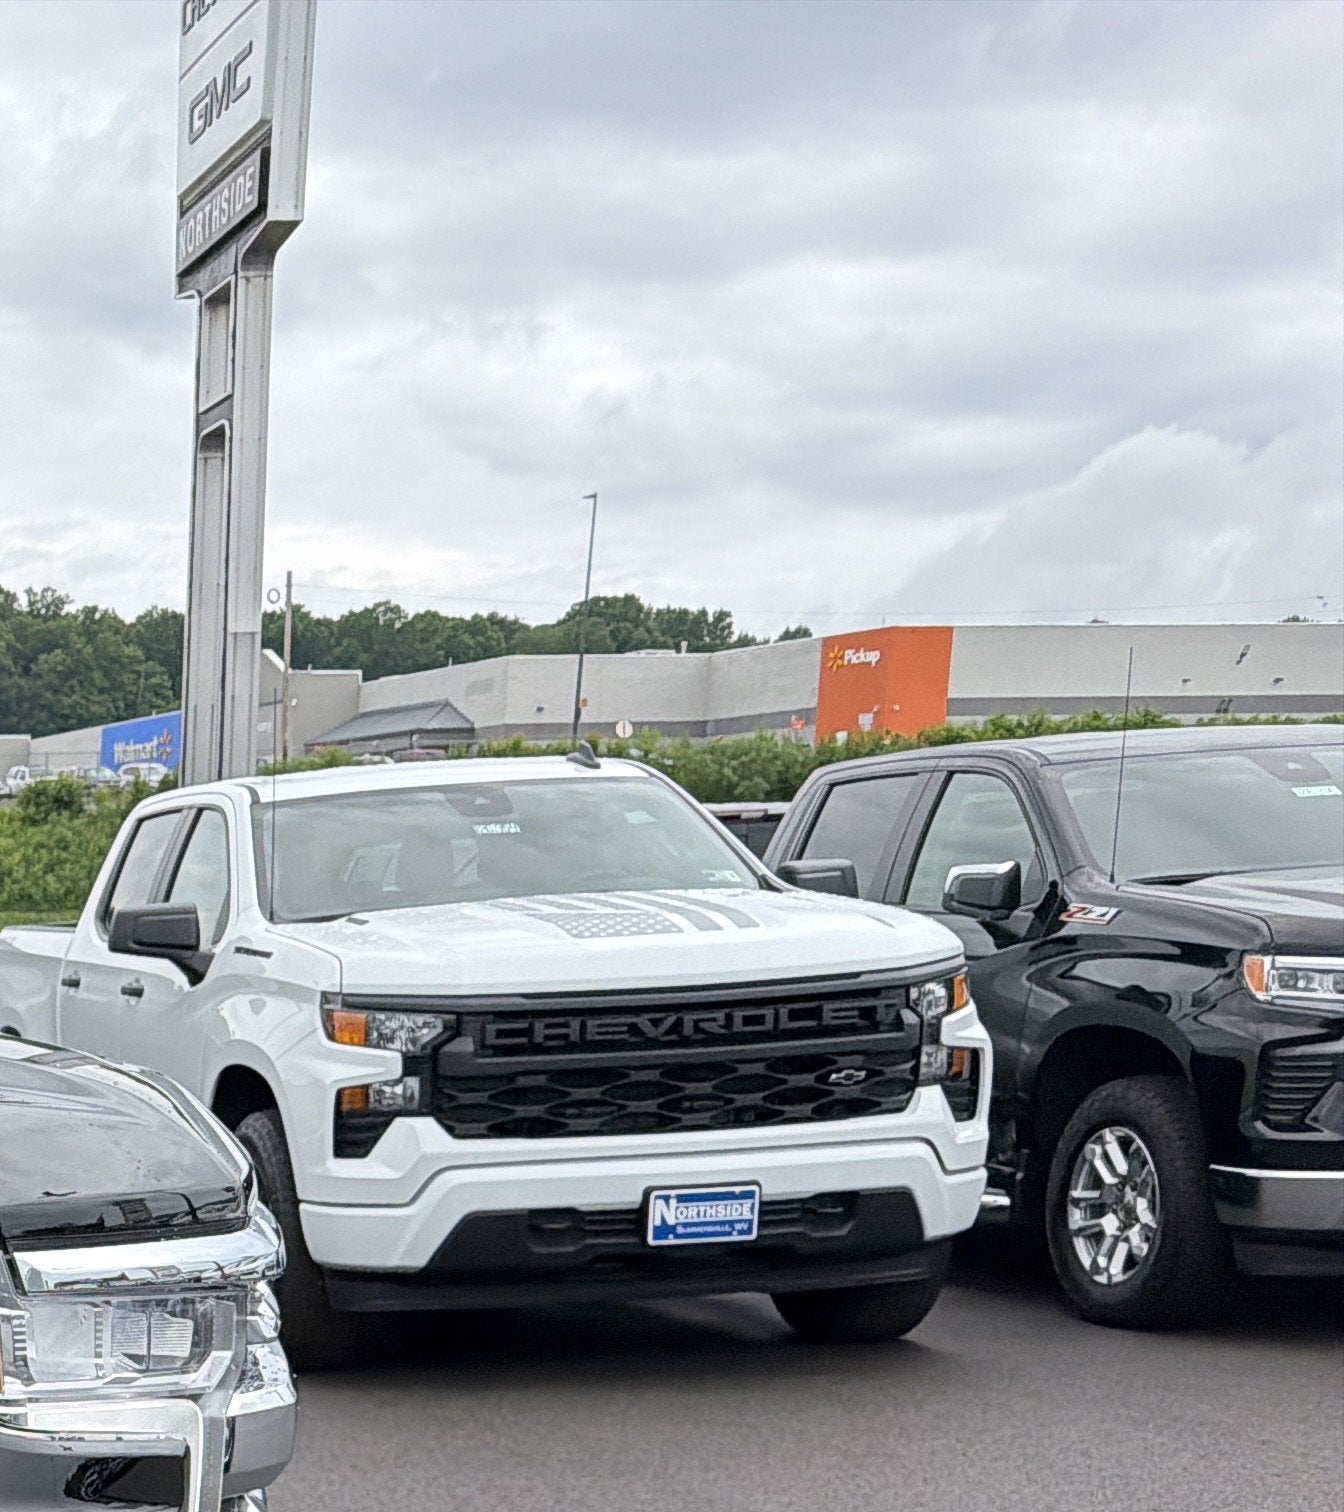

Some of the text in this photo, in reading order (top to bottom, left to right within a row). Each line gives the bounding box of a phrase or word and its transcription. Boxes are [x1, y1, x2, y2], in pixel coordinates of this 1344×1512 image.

[188, 40, 253, 145] GMC
[178, 165, 255, 262] NORTHSIDE
[843, 647, 880, 668] Pickup
[113, 736, 158, 765] Walmart
[485, 1000, 900, 1046] CHEVROLET
[653, 1198, 753, 1227] NORTHSIDE
